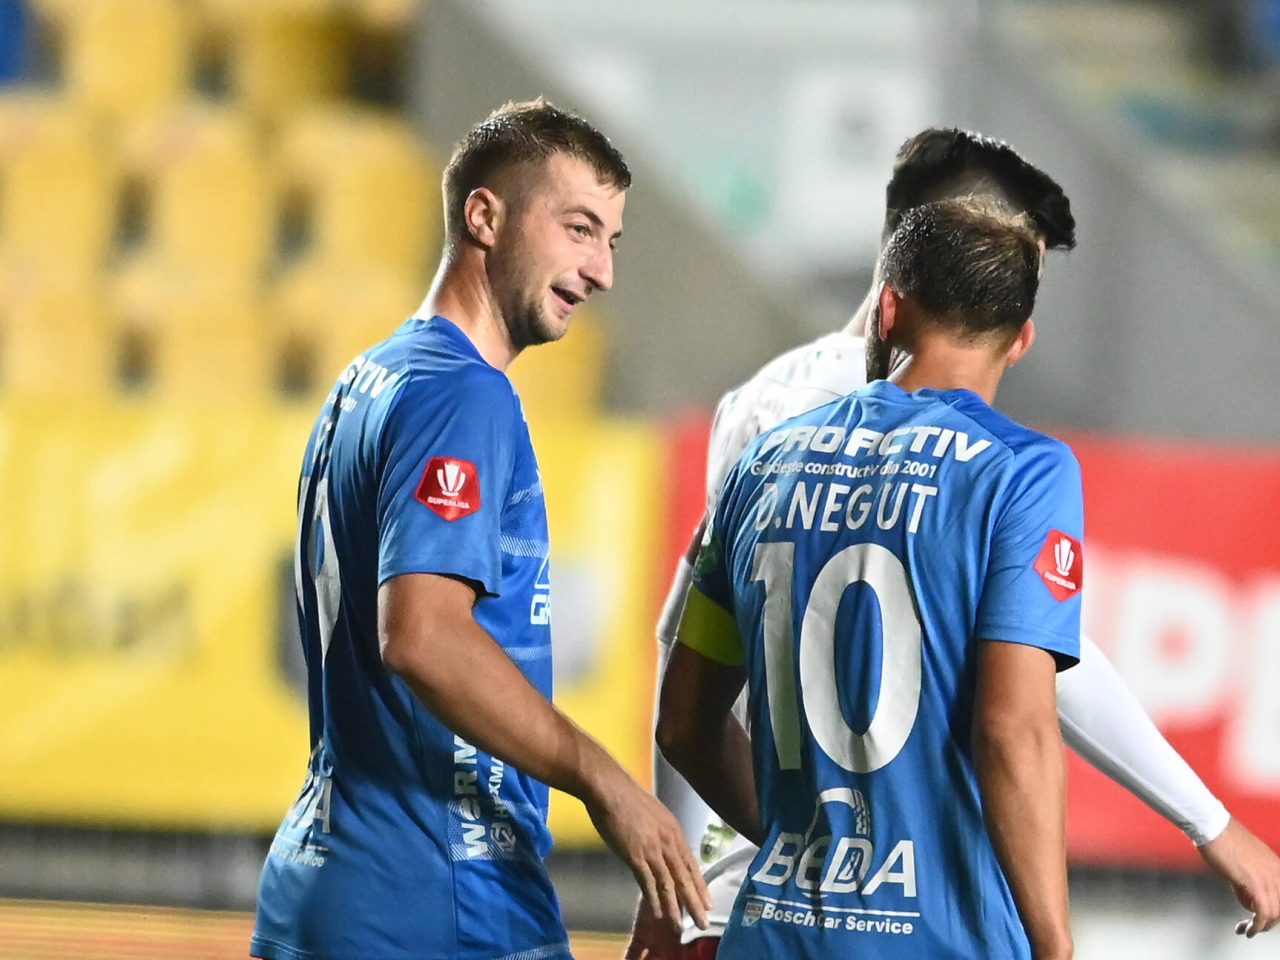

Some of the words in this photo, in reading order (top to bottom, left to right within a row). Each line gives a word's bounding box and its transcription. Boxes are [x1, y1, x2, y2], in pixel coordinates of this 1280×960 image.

[902, 459, 937, 479] 2001
[754, 480, 938, 534] D.NEGUT
[750, 541, 922, 775] 10
[762, 902, 815, 927] Bosch
[845, 915, 913, 935] Service
